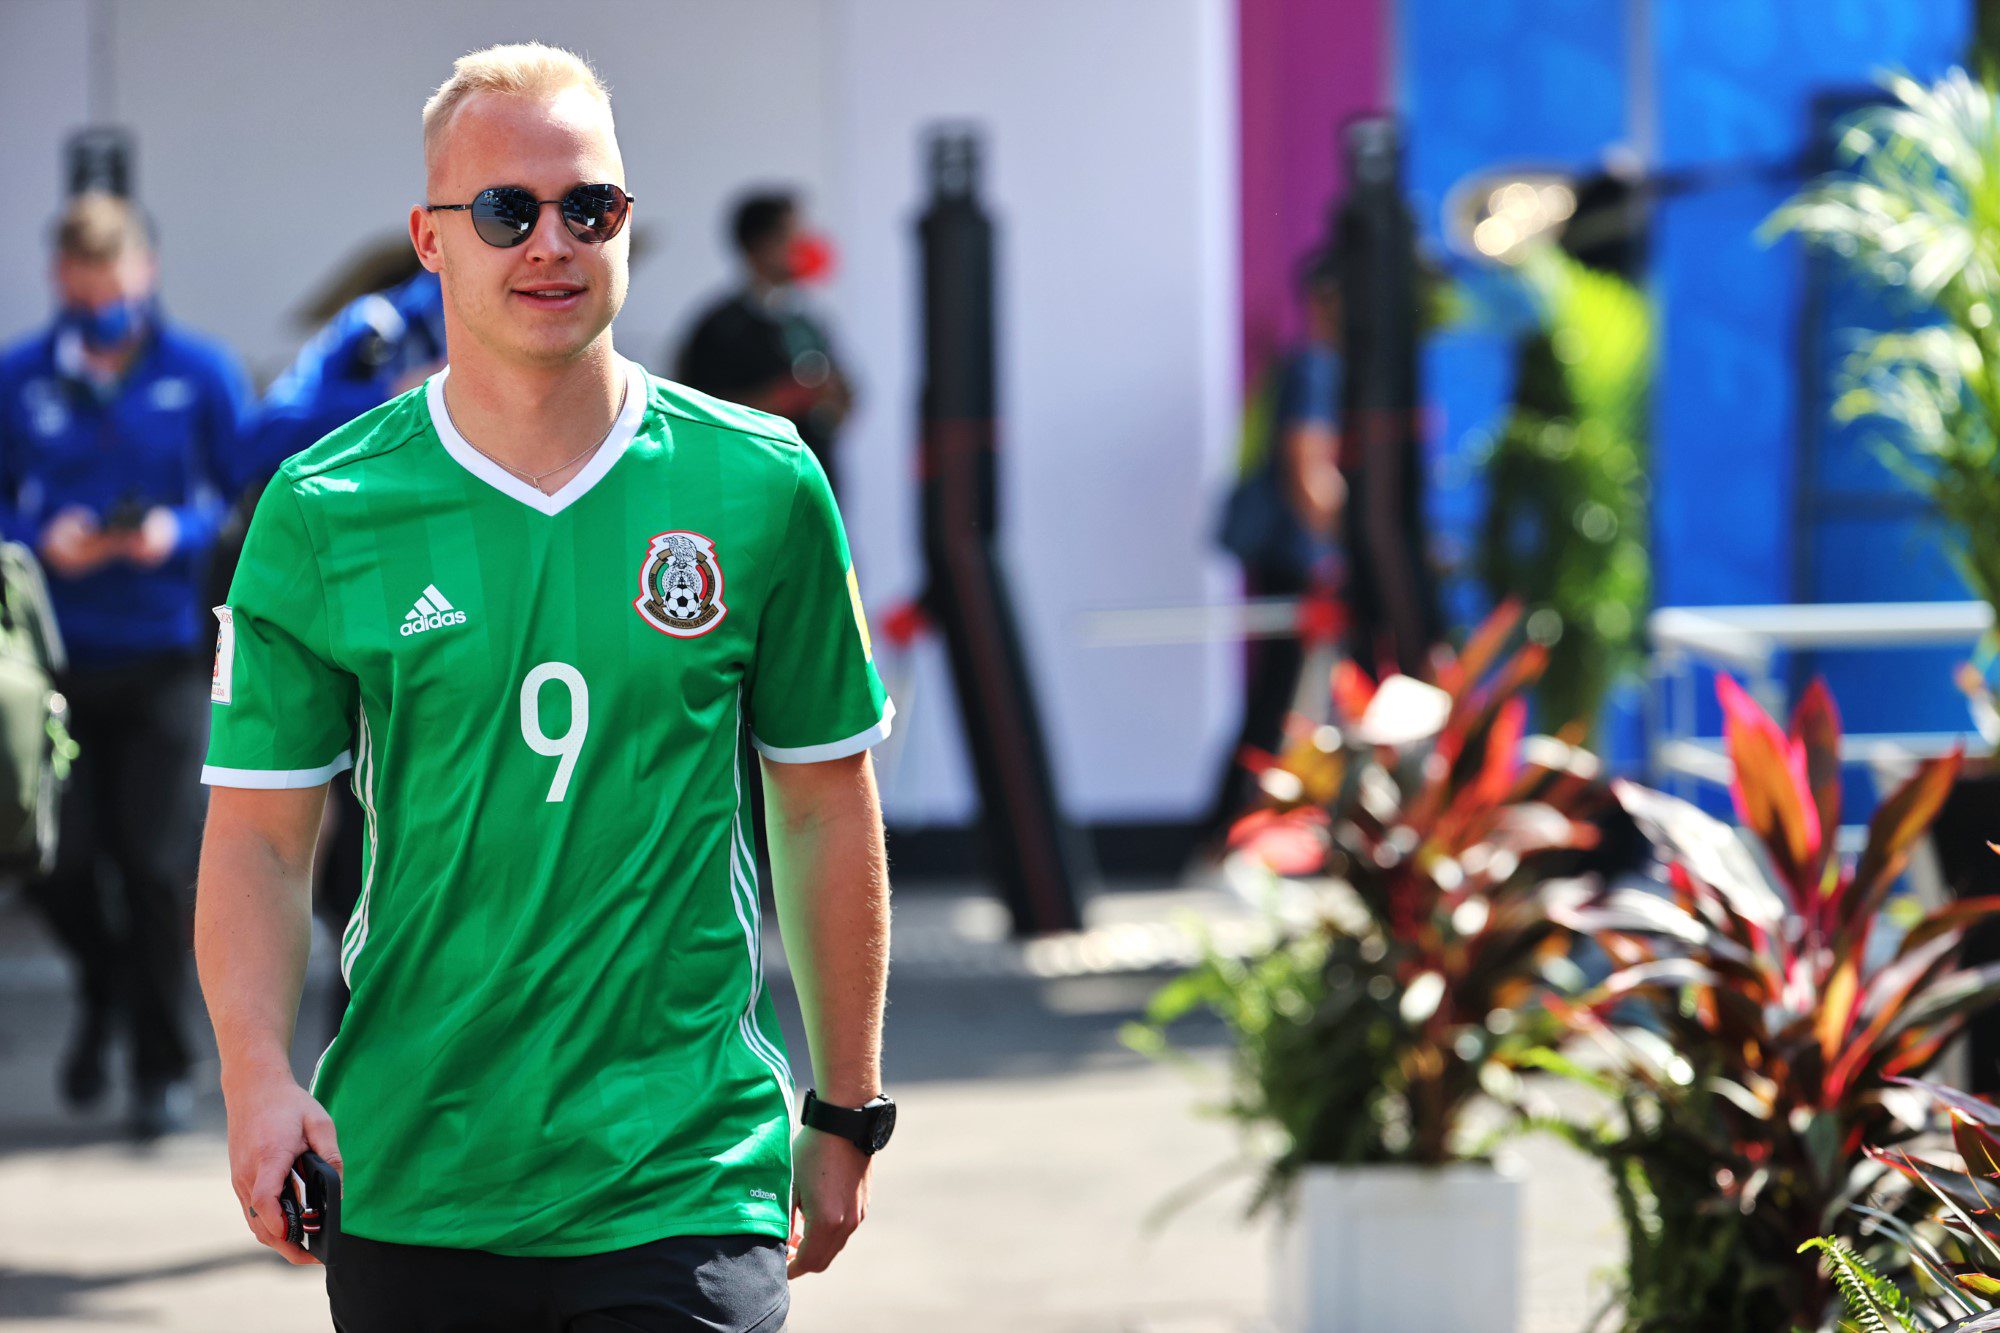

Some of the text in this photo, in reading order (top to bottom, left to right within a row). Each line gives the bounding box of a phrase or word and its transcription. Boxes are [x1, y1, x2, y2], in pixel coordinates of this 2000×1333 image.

[399, 610, 467, 636] adidas
[519, 661, 590, 803] 9
[749, 1188, 777, 1201] adizero
